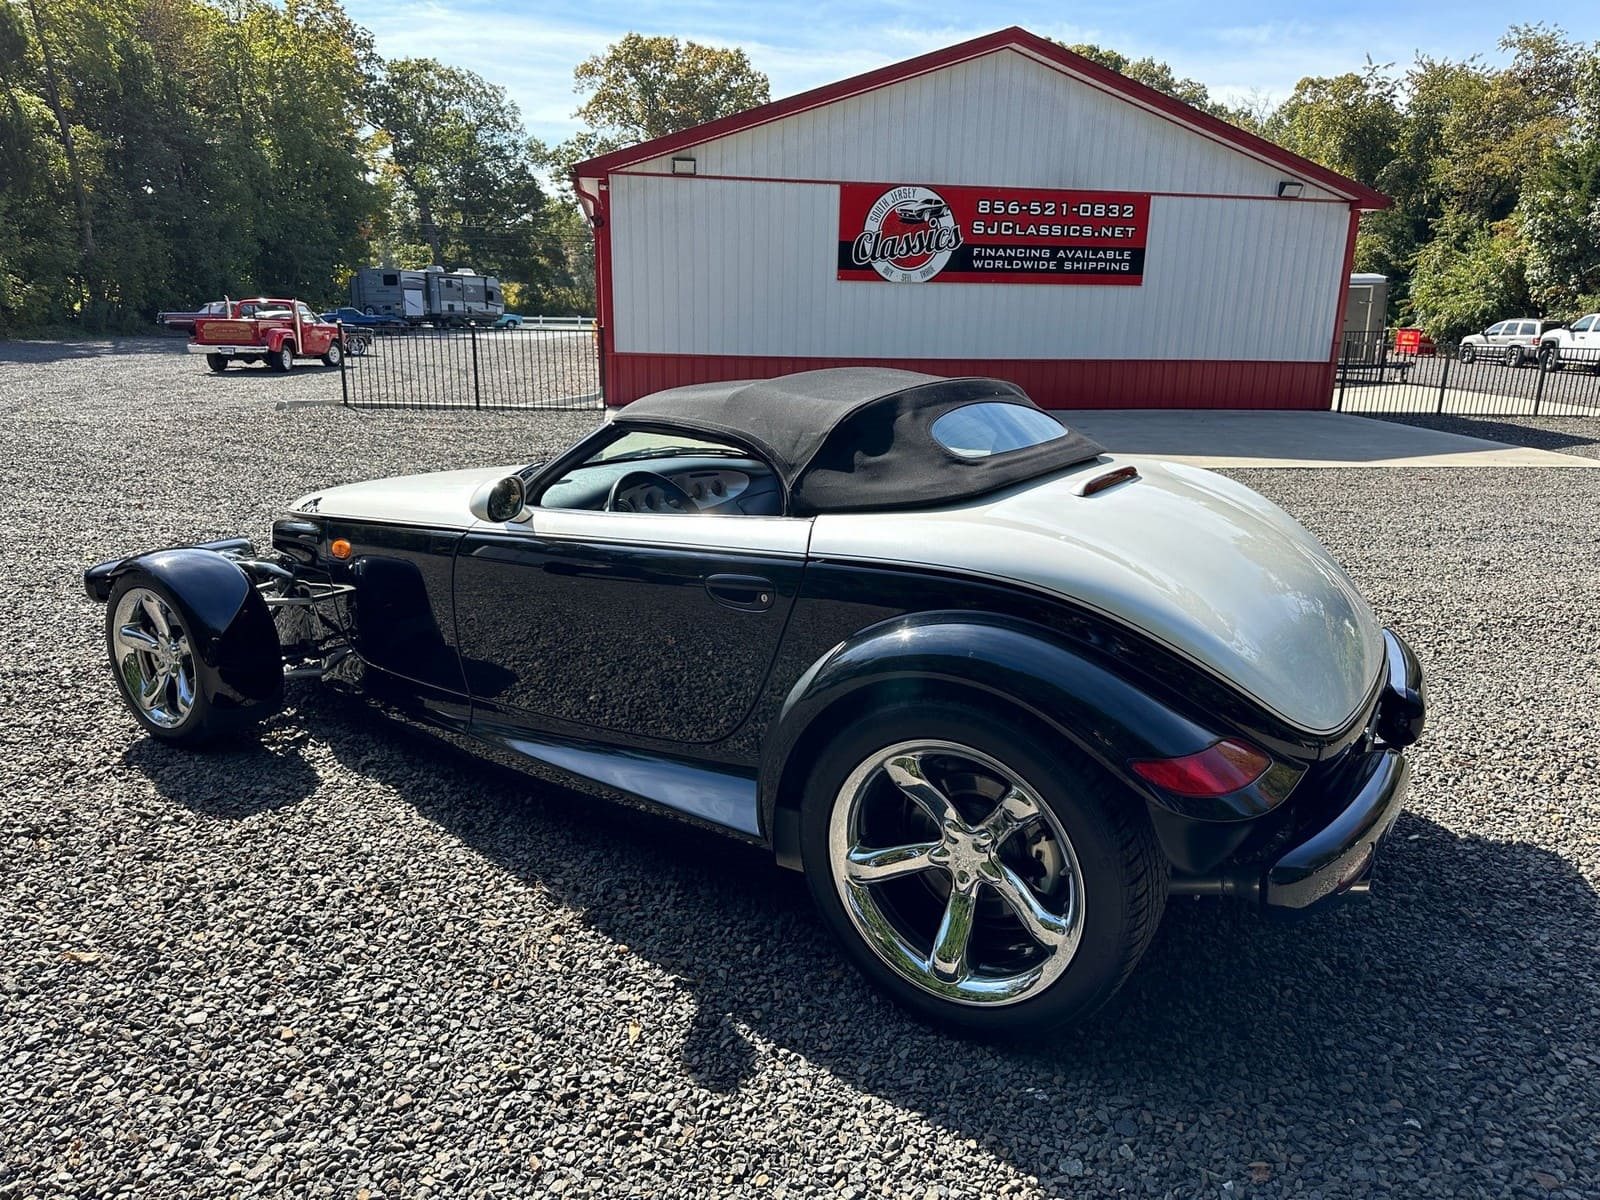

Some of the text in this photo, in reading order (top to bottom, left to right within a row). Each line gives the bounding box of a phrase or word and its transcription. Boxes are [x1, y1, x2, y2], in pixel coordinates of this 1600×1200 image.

[870, 189, 917, 223] SOUTH JERSEY
[978, 201, 1134, 217] 856-521-0832
[852, 217, 963, 265] Classics
[973, 248, 1131, 260] FINANCING AVAILABLE
[973, 260, 1130, 271] WORLDWIDE SHIPPING
